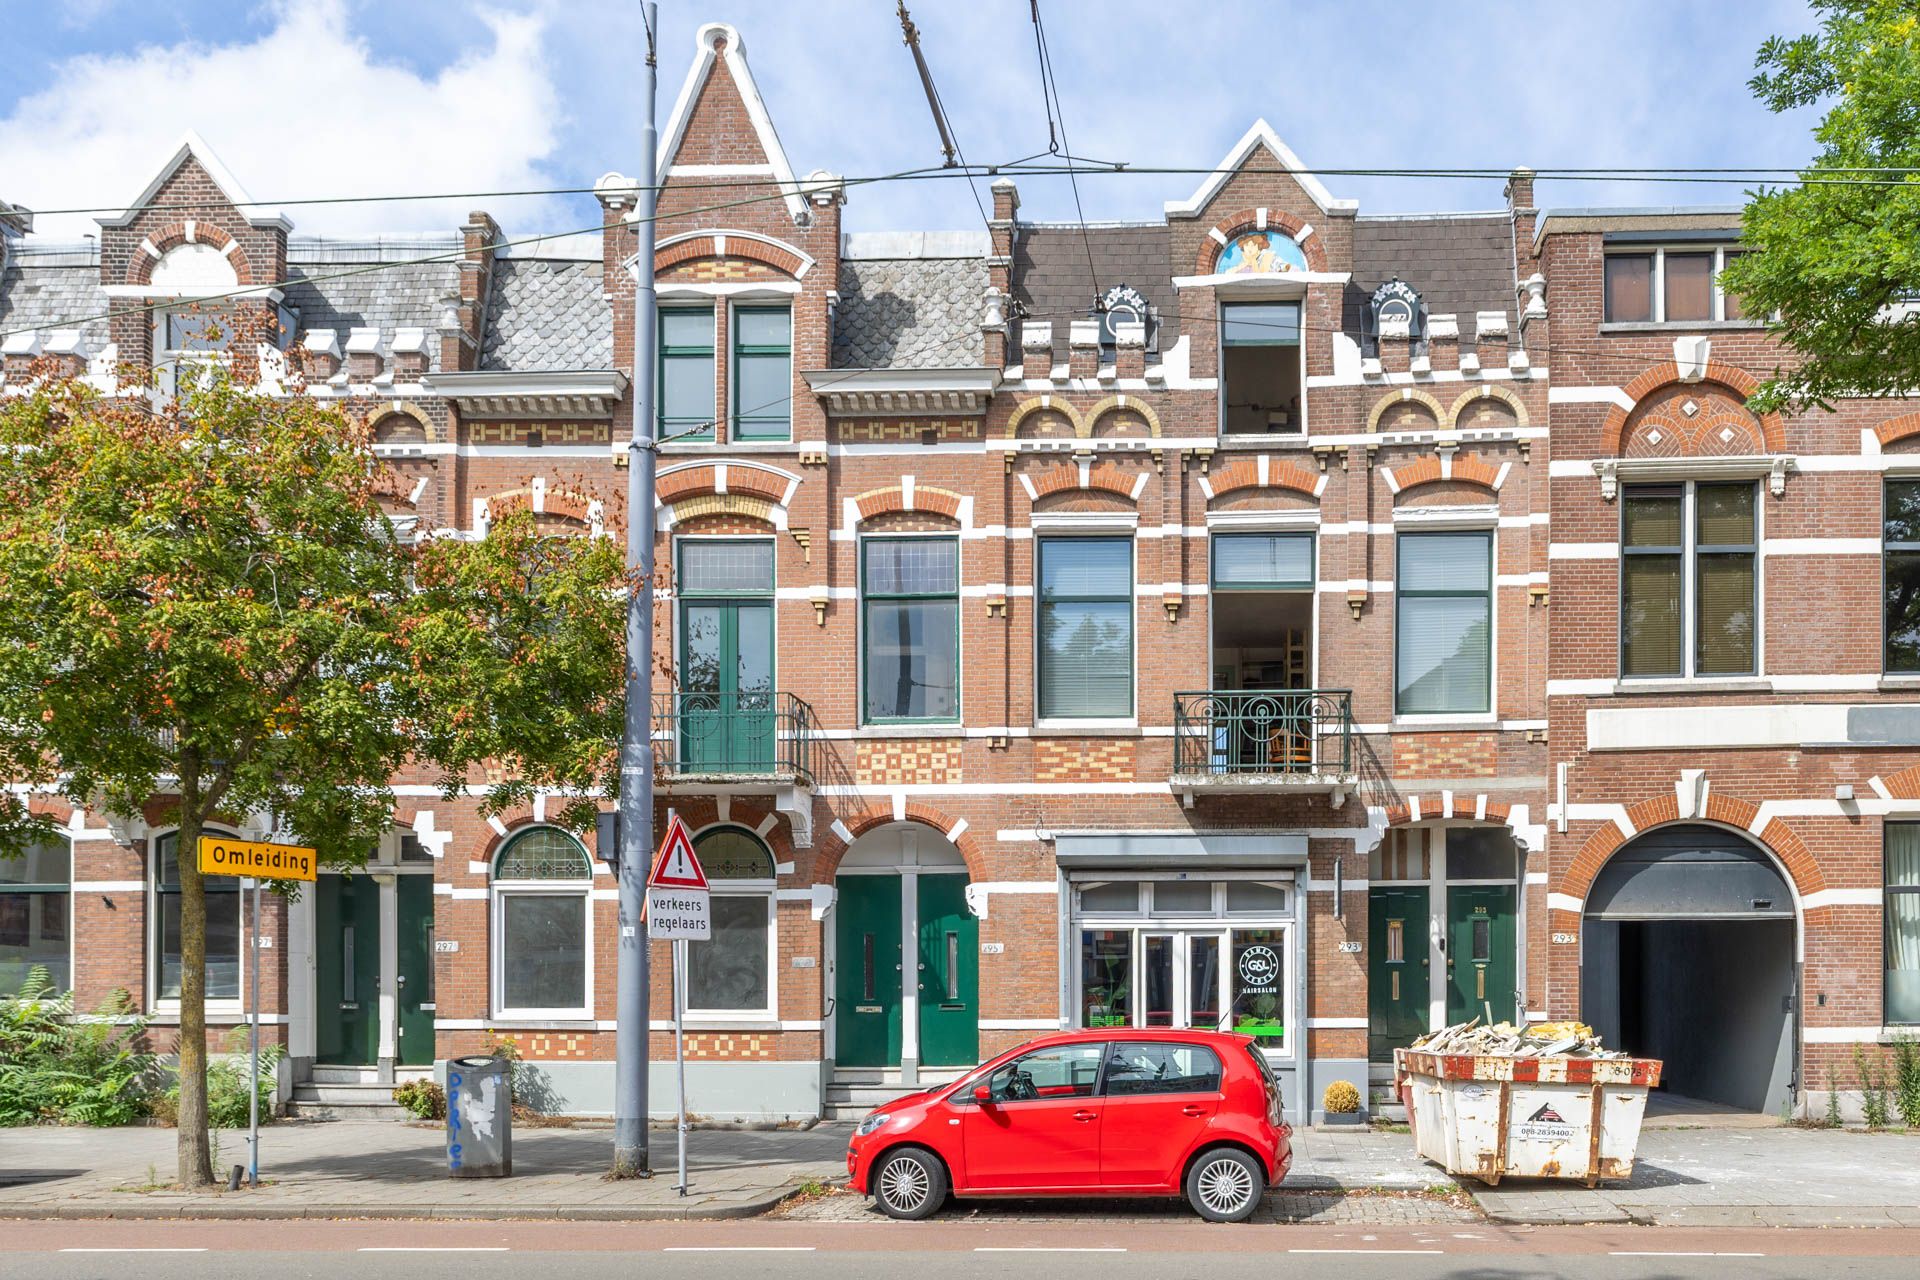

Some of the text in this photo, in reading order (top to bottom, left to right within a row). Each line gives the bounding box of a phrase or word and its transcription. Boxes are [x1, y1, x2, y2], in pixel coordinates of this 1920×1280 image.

[213, 846, 309, 875] Omleiding
[653, 897, 702, 911] verkeers
[654, 916, 706, 932] regelaars
[1248, 959, 1270, 972] G&L
